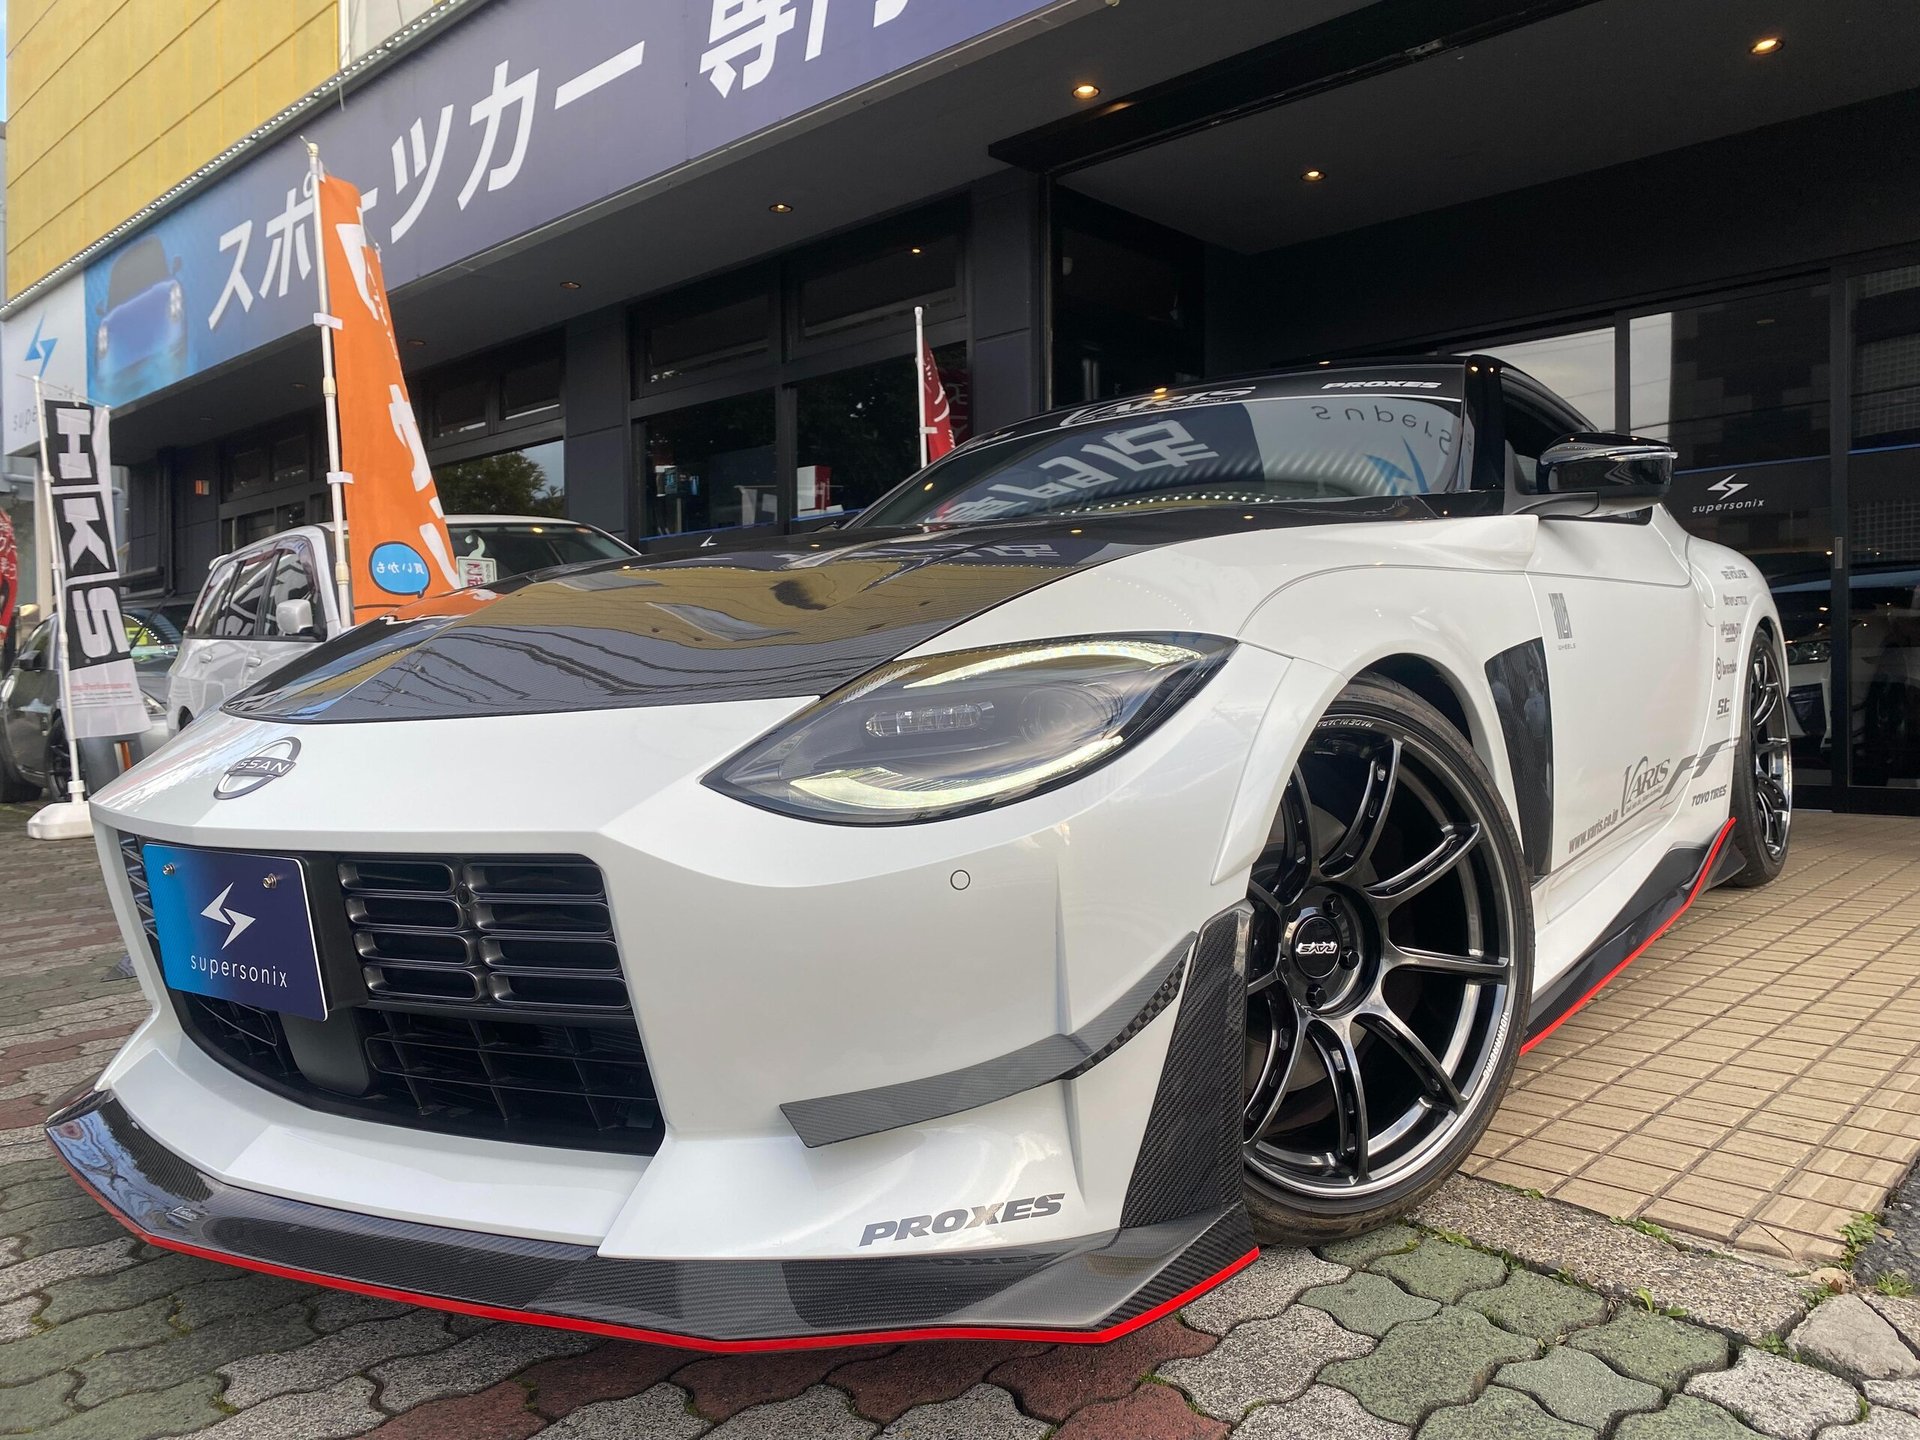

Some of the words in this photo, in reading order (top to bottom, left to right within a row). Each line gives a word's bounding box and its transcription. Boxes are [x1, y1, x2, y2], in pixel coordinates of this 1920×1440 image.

[208, 40, 645, 331] スポツカー
[1321, 381, 1442, 390] PROXES
[1691, 498, 1765, 515] supersonix
[56, 408, 131, 658] HKS
[1620, 756, 1671, 818] VARIS
[1691, 790, 1711, 807] TOYO
[1711, 784, 1728, 802] TIRES
[1296, 941, 1337, 954] RAYS
[190, 954, 288, 988] supersonix
[859, 1193, 1065, 1247] PROXES
